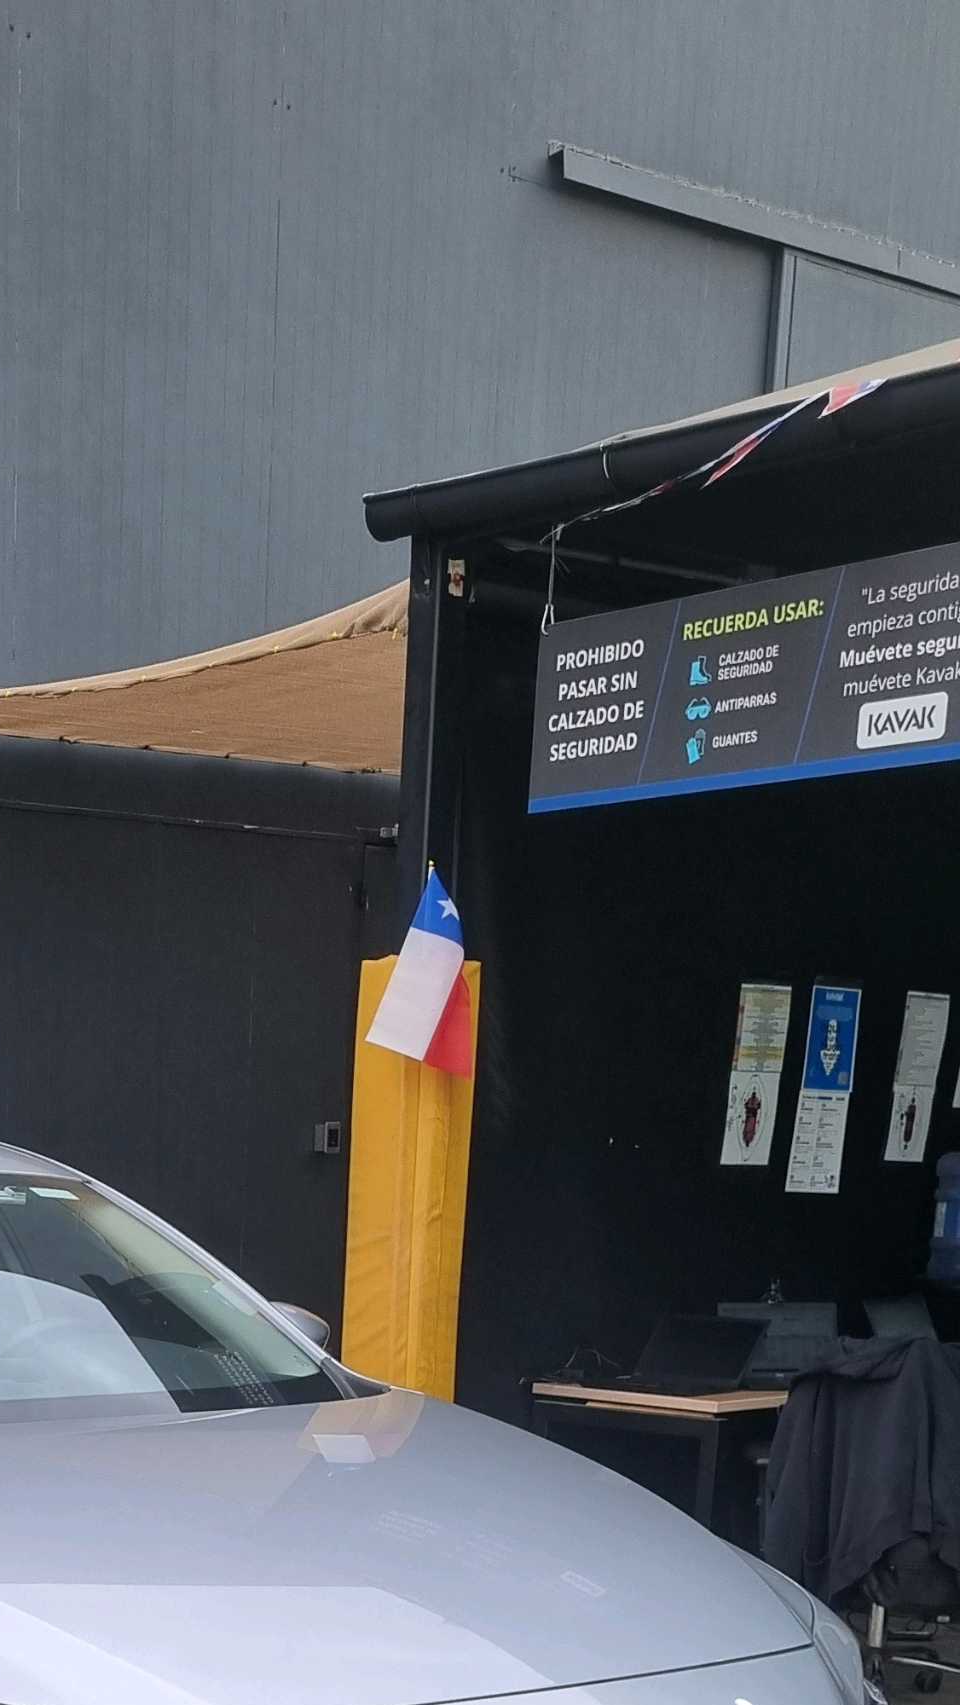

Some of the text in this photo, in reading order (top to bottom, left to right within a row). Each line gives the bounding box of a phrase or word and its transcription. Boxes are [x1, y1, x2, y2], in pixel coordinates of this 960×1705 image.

[862, 571, 959, 605] "La segurida
[683, 599, 825, 641] RECUERDA USAR:
[847, 613, 914, 639] empieza
[556, 639, 645, 672] PROHIBIDO
[718, 644, 780, 667] CALZADO DE
[839, 644, 913, 669] Muévete
[717, 660, 774, 681] SEGURIDAD
[558, 670, 638, 702] PASAR SIN
[843, 673, 912, 697] muévete
[548, 700, 645, 732] CALZADO DE
[714, 691, 778, 714] ANTIPARRAS
[867, 705, 936, 737] KAVAK
[549, 732, 638, 762] SEGURIDAD
[712, 730, 758, 749] GUANTES
